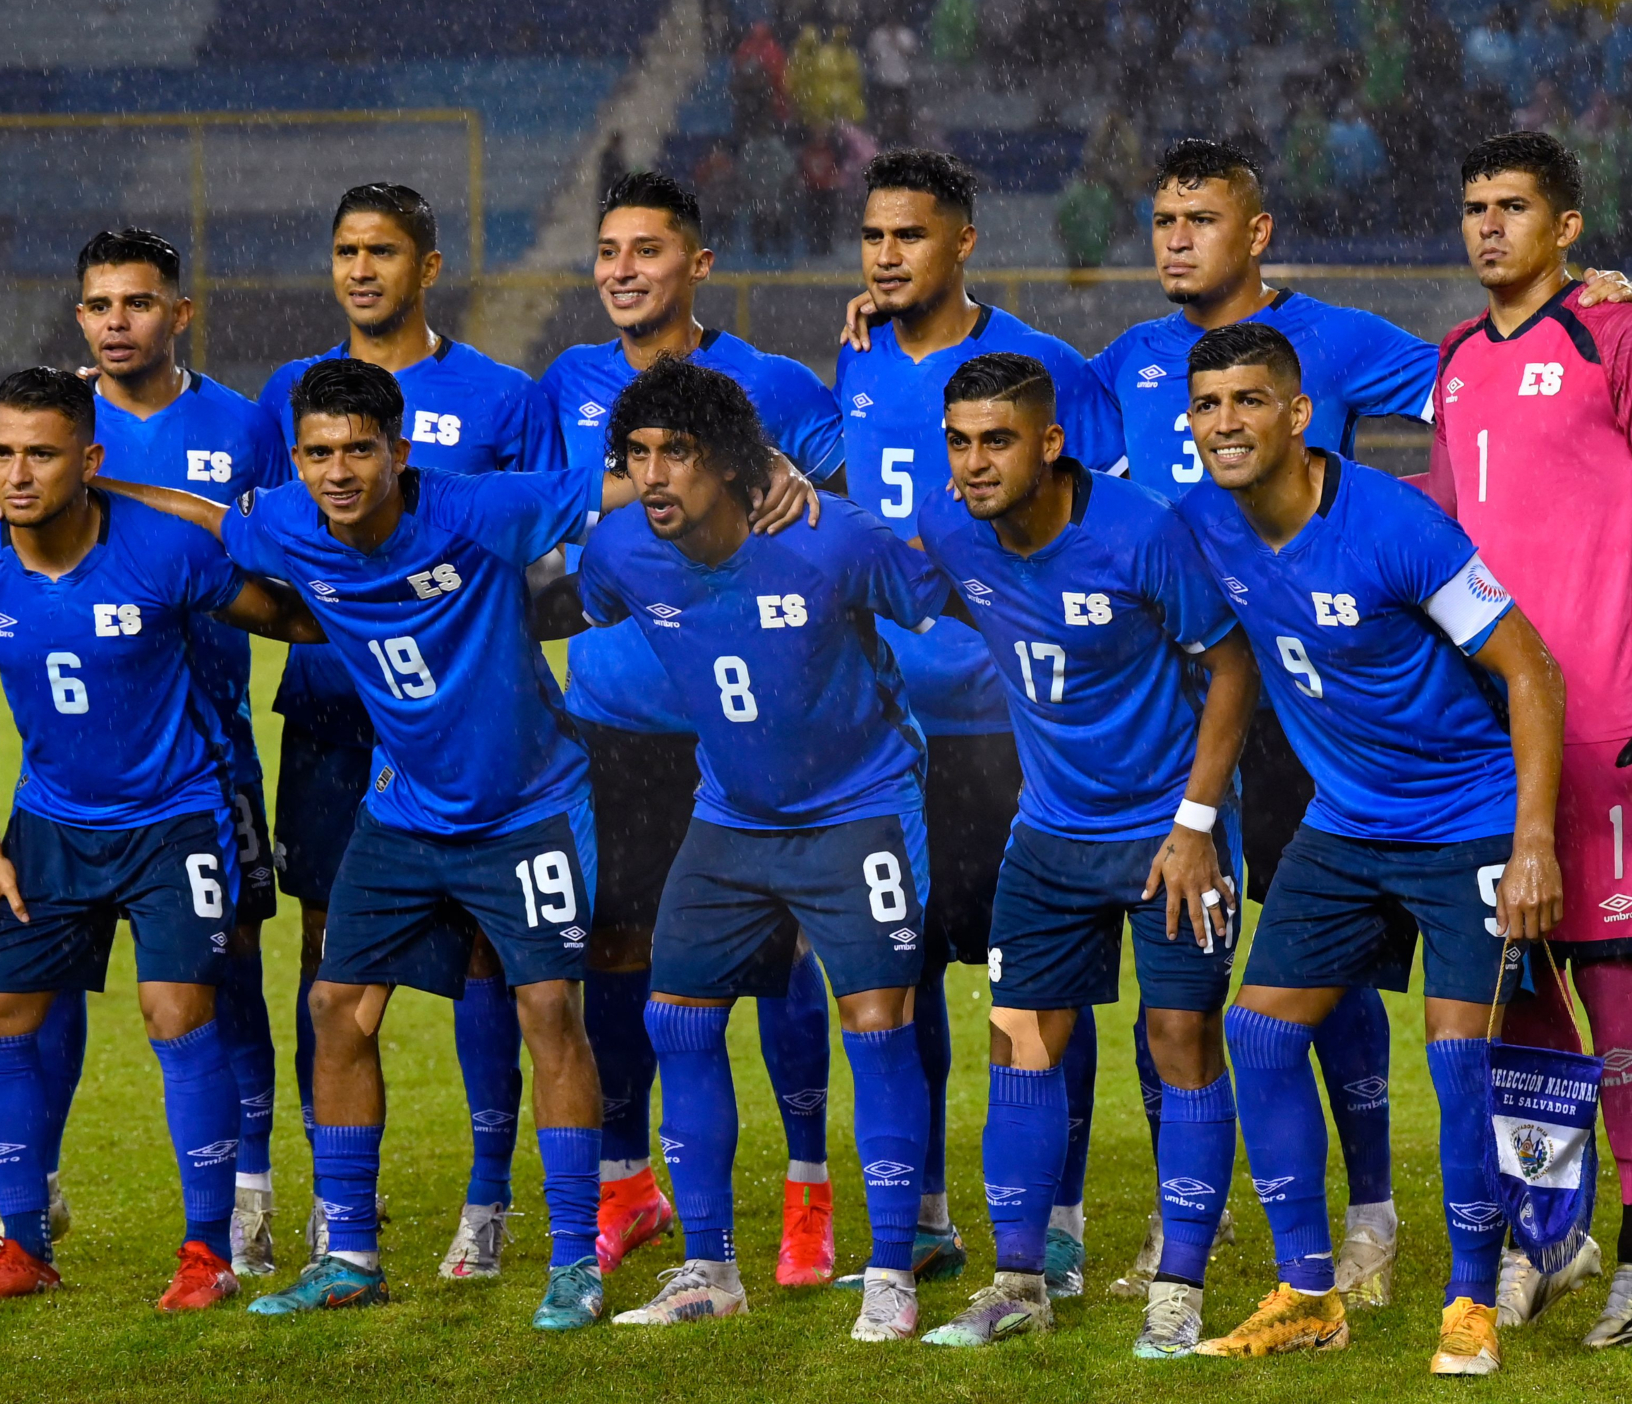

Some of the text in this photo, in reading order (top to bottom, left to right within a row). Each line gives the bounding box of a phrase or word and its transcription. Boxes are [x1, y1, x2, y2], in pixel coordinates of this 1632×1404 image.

[1517, 361, 1565, 397] ES
[411, 410, 462, 447] ES
[186, 449, 233, 484] ES
[880, 447, 915, 519] 5
[1476, 428, 1489, 503] 1
[406, 562, 463, 601] ES
[92, 603, 143, 637] ES
[652, 617, 681, 629] umbro
[756, 593, 809, 629] ES
[1061, 591, 1113, 626] ES
[1311, 591, 1361, 627] ES
[45, 651, 90, 715] 6
[367, 635, 437, 700] 19
[1013, 640, 1066, 704] 17
[1275, 635, 1323, 699] 9
[713, 655, 759, 723] 8
[1608, 804, 1624, 880] 1
[185, 853, 224, 919] 6
[515, 850, 577, 928] 19
[862, 850, 908, 923] 8
[987, 947, 1003, 982] S
[1491, 1068, 1598, 1103] SELECCIÓN NACIONAL
[1347, 1096, 1388, 1112] umbro
[1503, 1093, 1577, 1116] EL SALVADOR
[868, 1179, 910, 1187] umbro
[1164, 1194, 1205, 1211] umbro
[1452, 1219, 1506, 1232] umbro
